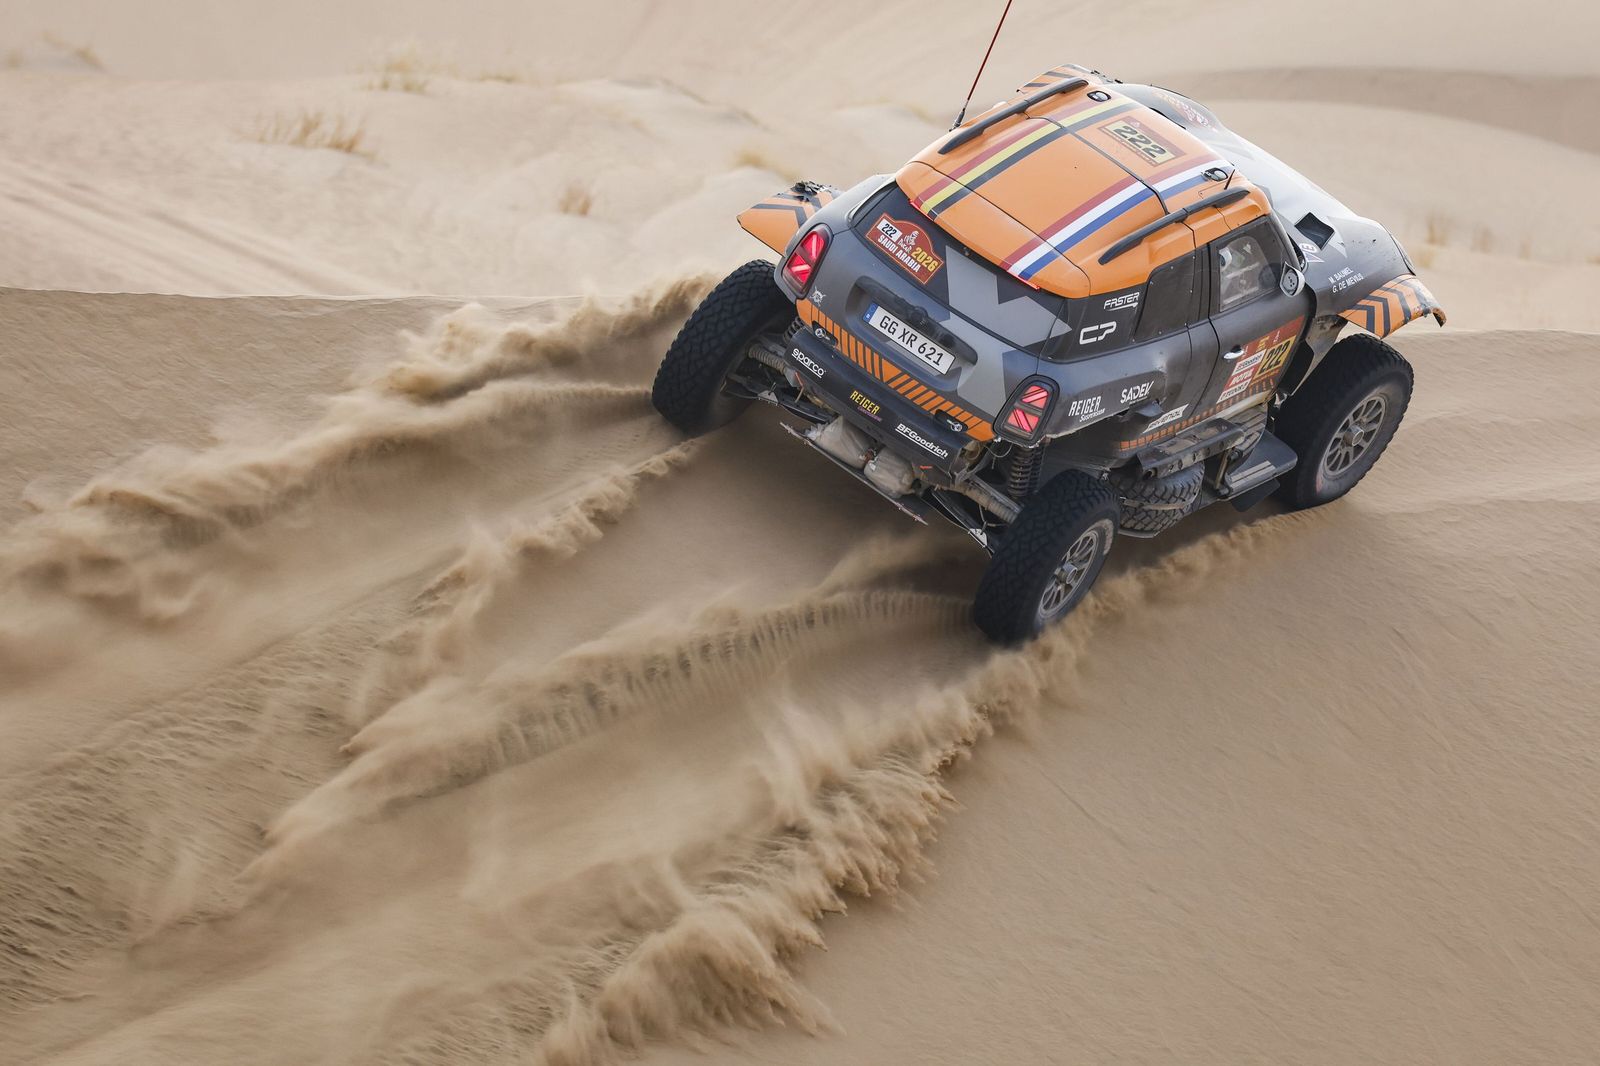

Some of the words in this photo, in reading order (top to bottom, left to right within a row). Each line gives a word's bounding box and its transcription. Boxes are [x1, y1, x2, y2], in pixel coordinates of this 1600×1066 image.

[1113, 125, 1167, 158] 222
[881, 223, 897, 239] 222
[878, 235, 898, 254] SAUDI
[895, 250, 921, 273] ARABIA
[911, 247, 939, 272] 2026
[1338, 280, 1347, 291] DE
[1103, 291, 1140, 310] FASTER
[879, 315, 899, 336] GG
[898, 328, 918, 348] XR
[917, 342, 944, 366] 621
[792, 348, 824, 377] sparco
[1258, 340, 1291, 374] 222
[850, 390, 880, 415] REIGER
[1120, 380, 1155, 404] SADEV
[1068, 395, 1102, 417] REIGER
[896, 423, 949, 458] BFGoodrich
